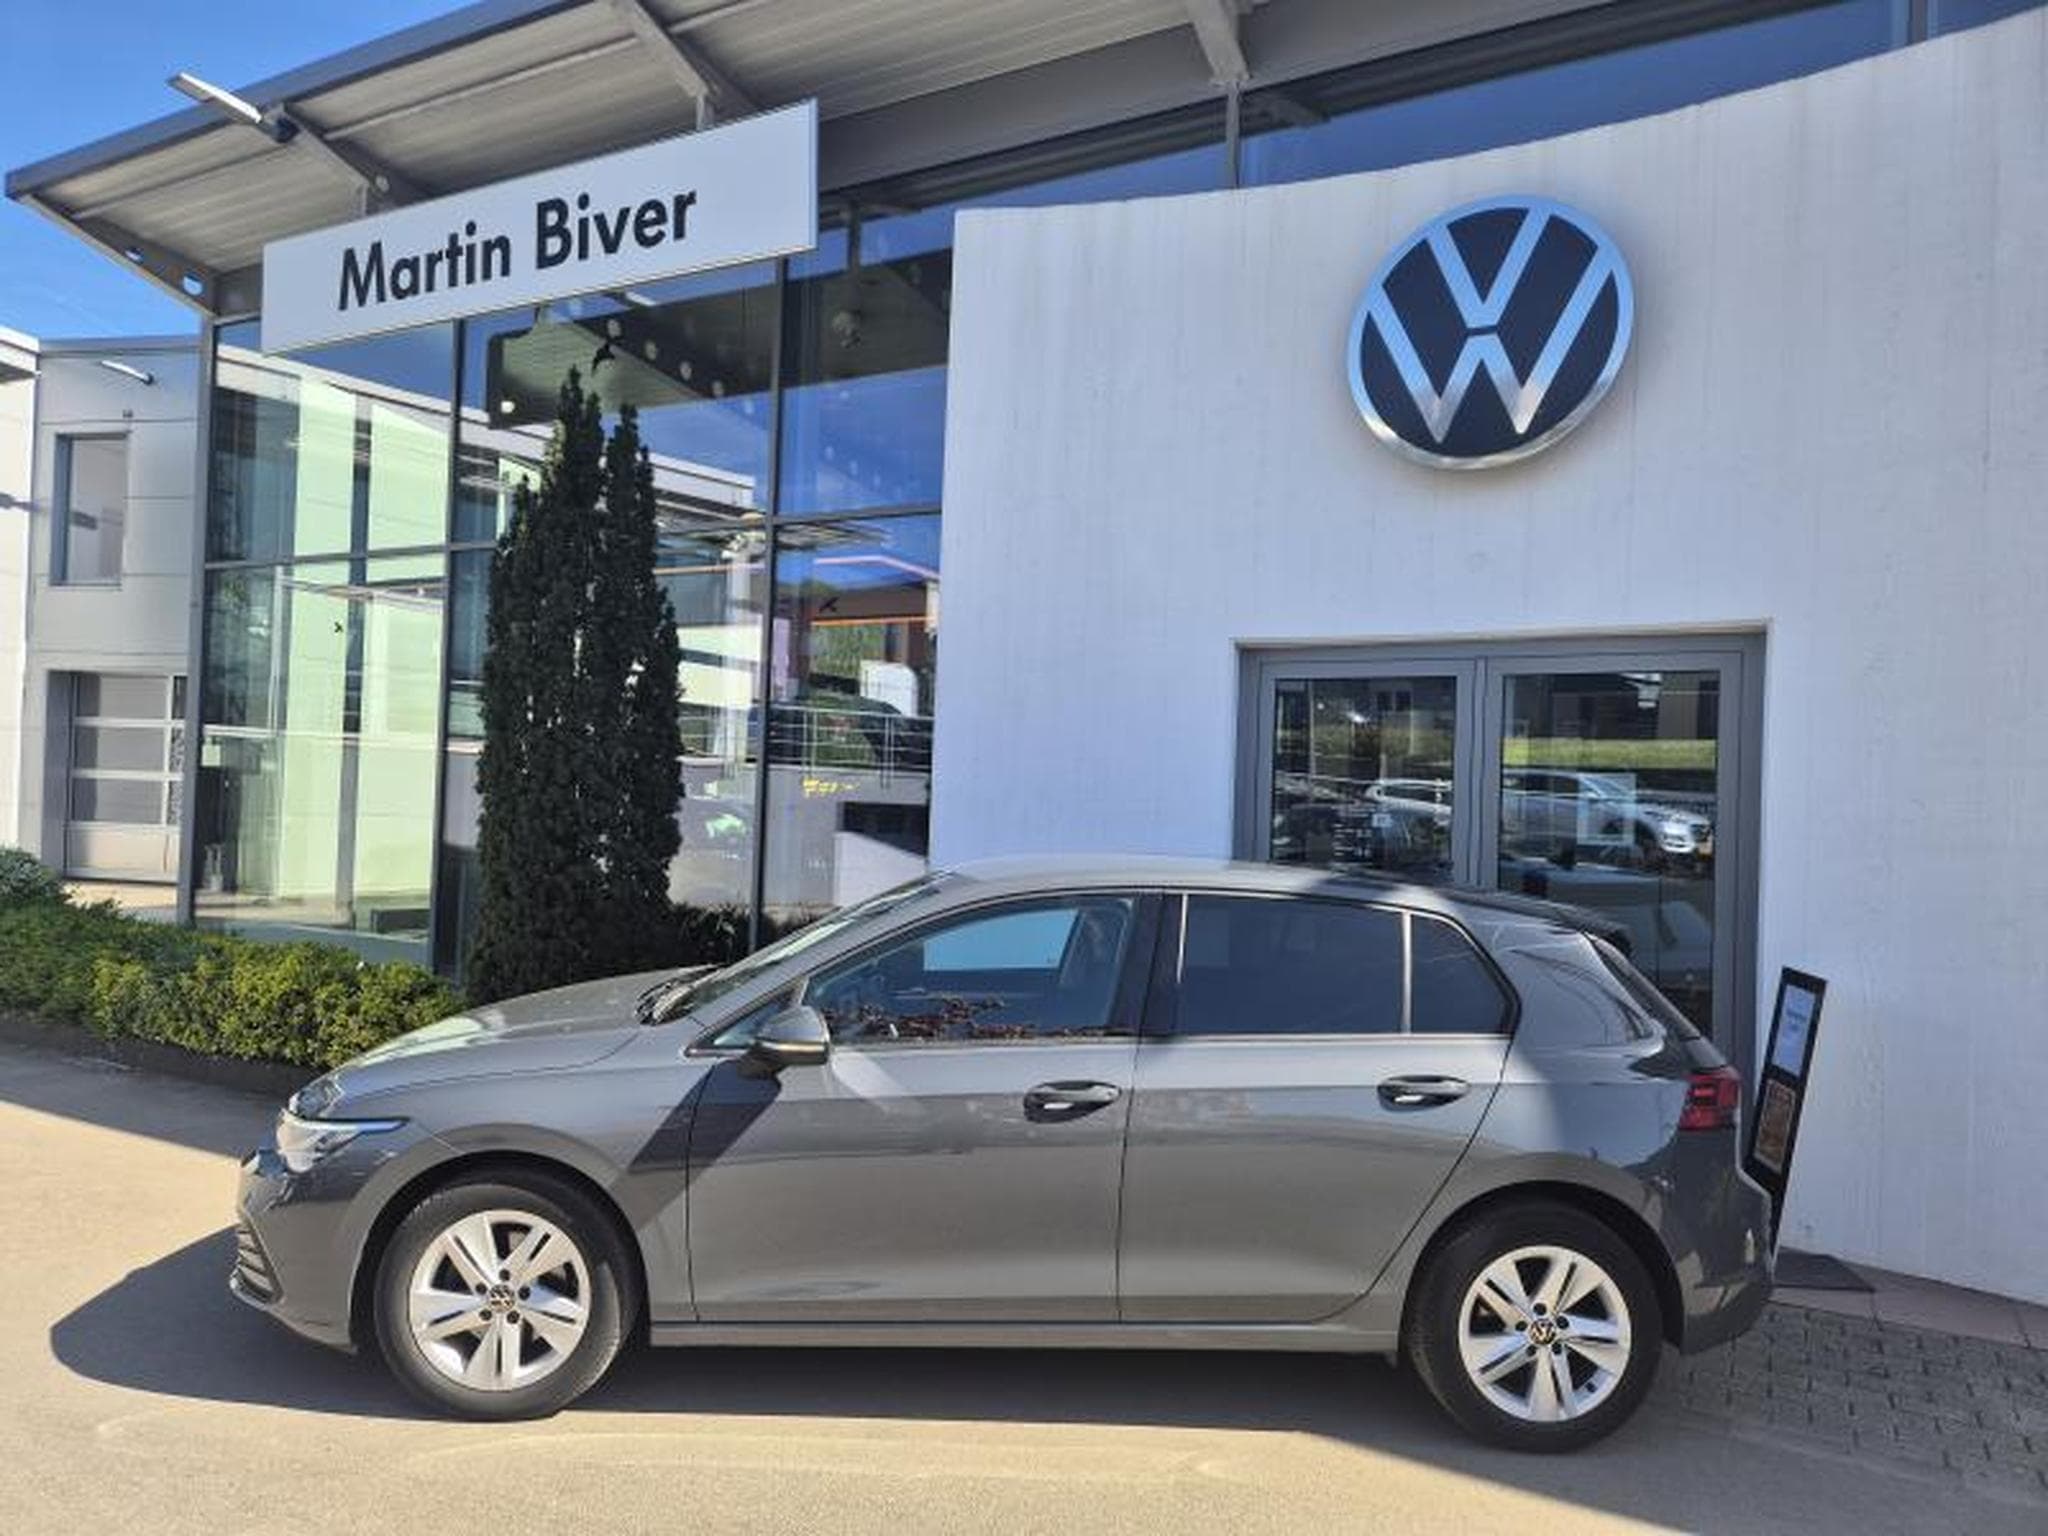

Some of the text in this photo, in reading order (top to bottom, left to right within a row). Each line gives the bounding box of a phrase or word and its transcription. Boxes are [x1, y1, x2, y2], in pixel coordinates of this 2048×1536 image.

[338, 190, 697, 311] Martin Biver
[1357, 200, 1620, 445] VW
